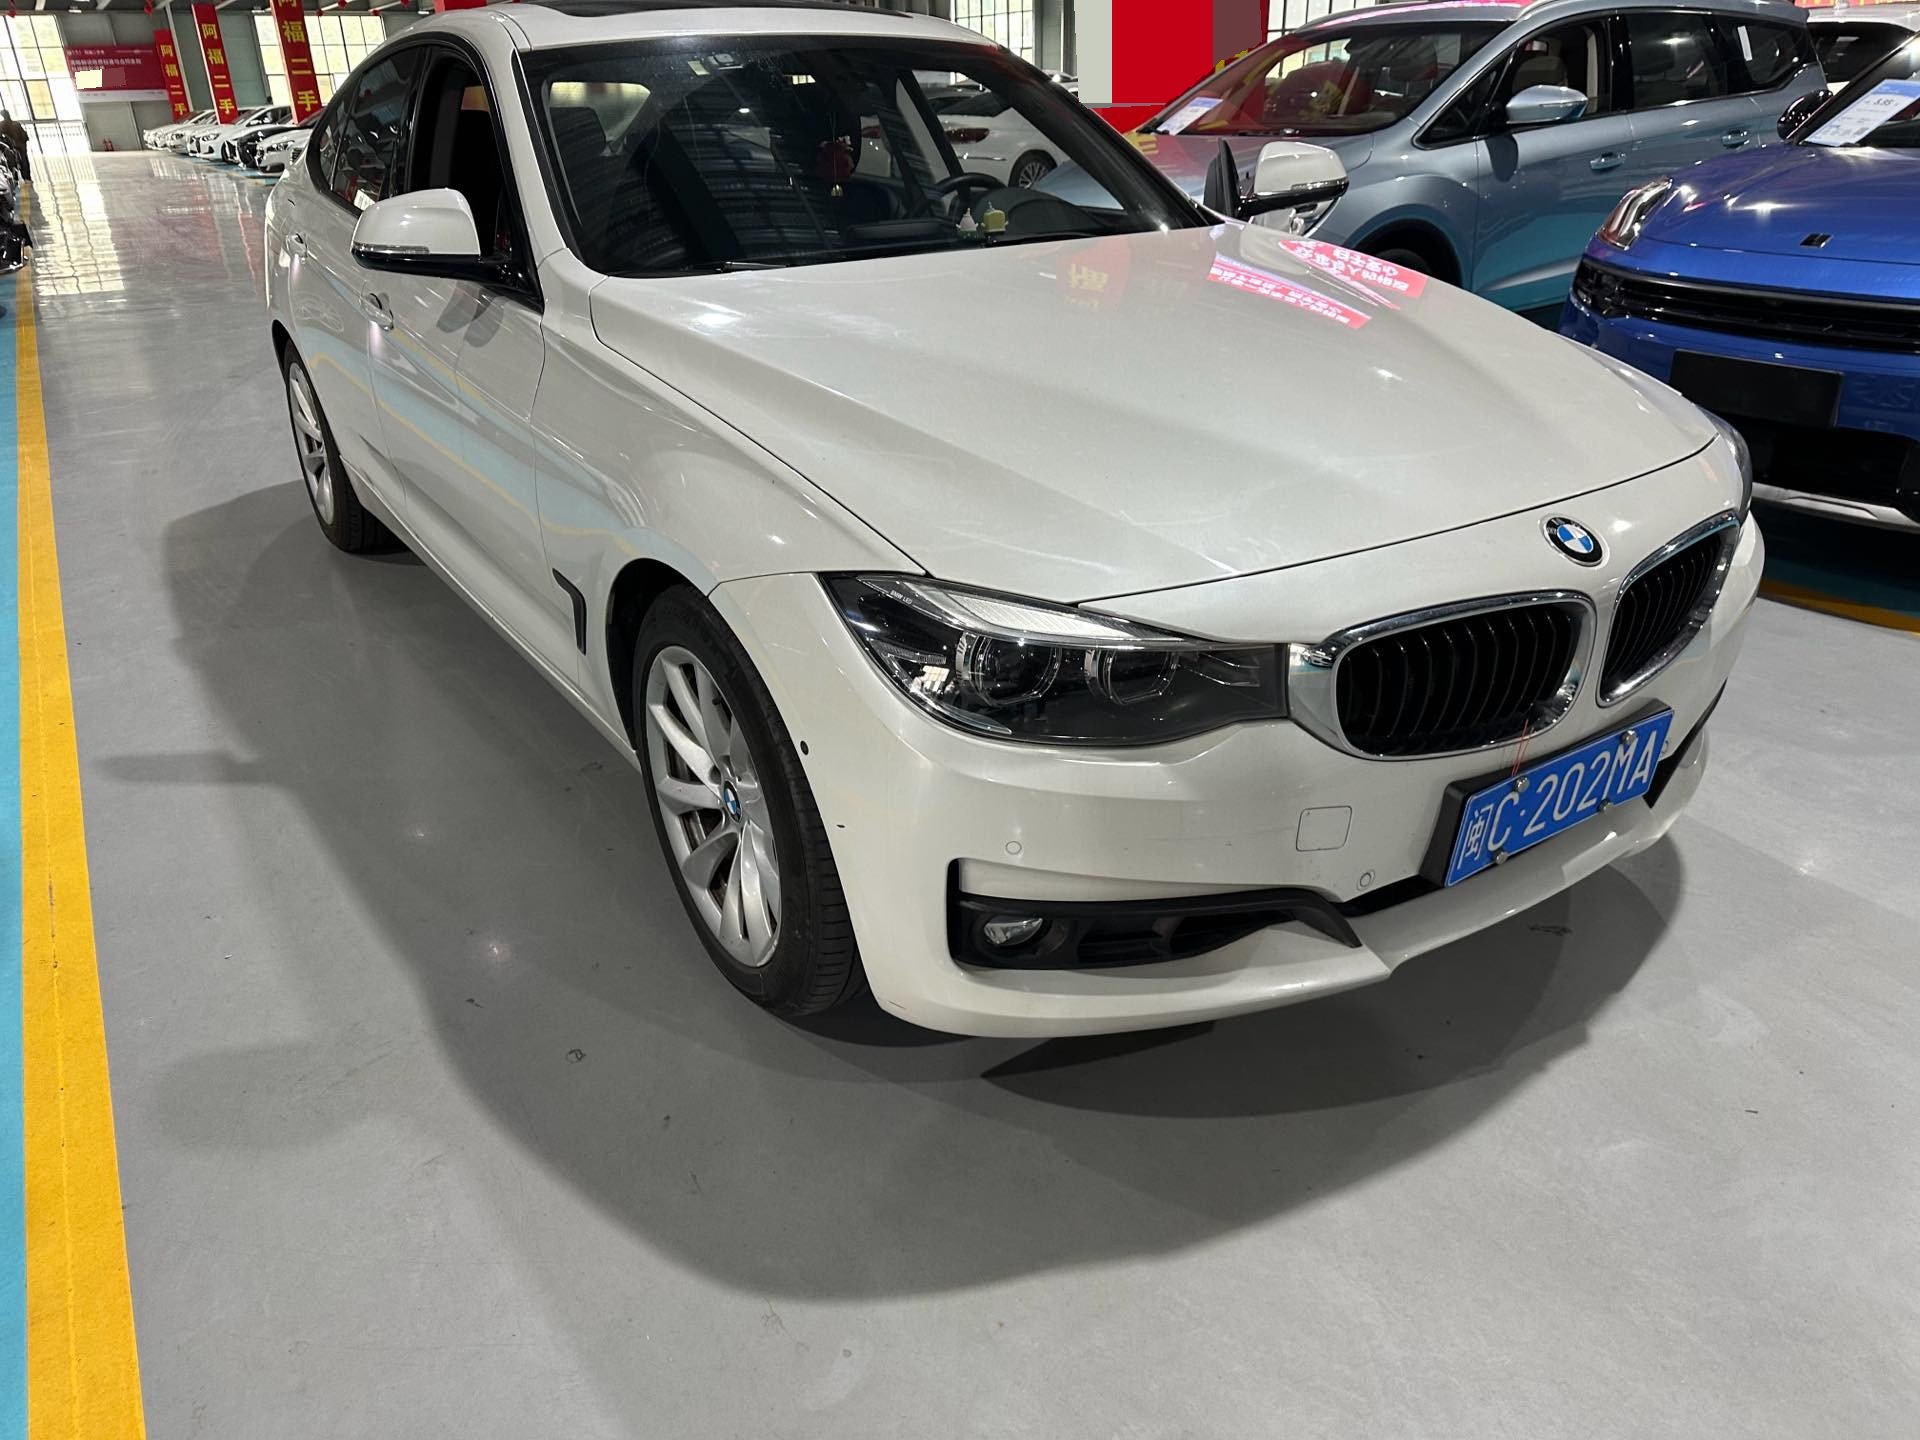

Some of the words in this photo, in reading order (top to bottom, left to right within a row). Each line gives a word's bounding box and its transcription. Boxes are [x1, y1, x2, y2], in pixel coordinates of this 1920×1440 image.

[160, 44, 187, 115] 阿福二手
[201, 23, 235, 115] 阿福二手
[902, 596, 913, 605] LED
[1457, 730, 1657, 870] 闽C·202MA
